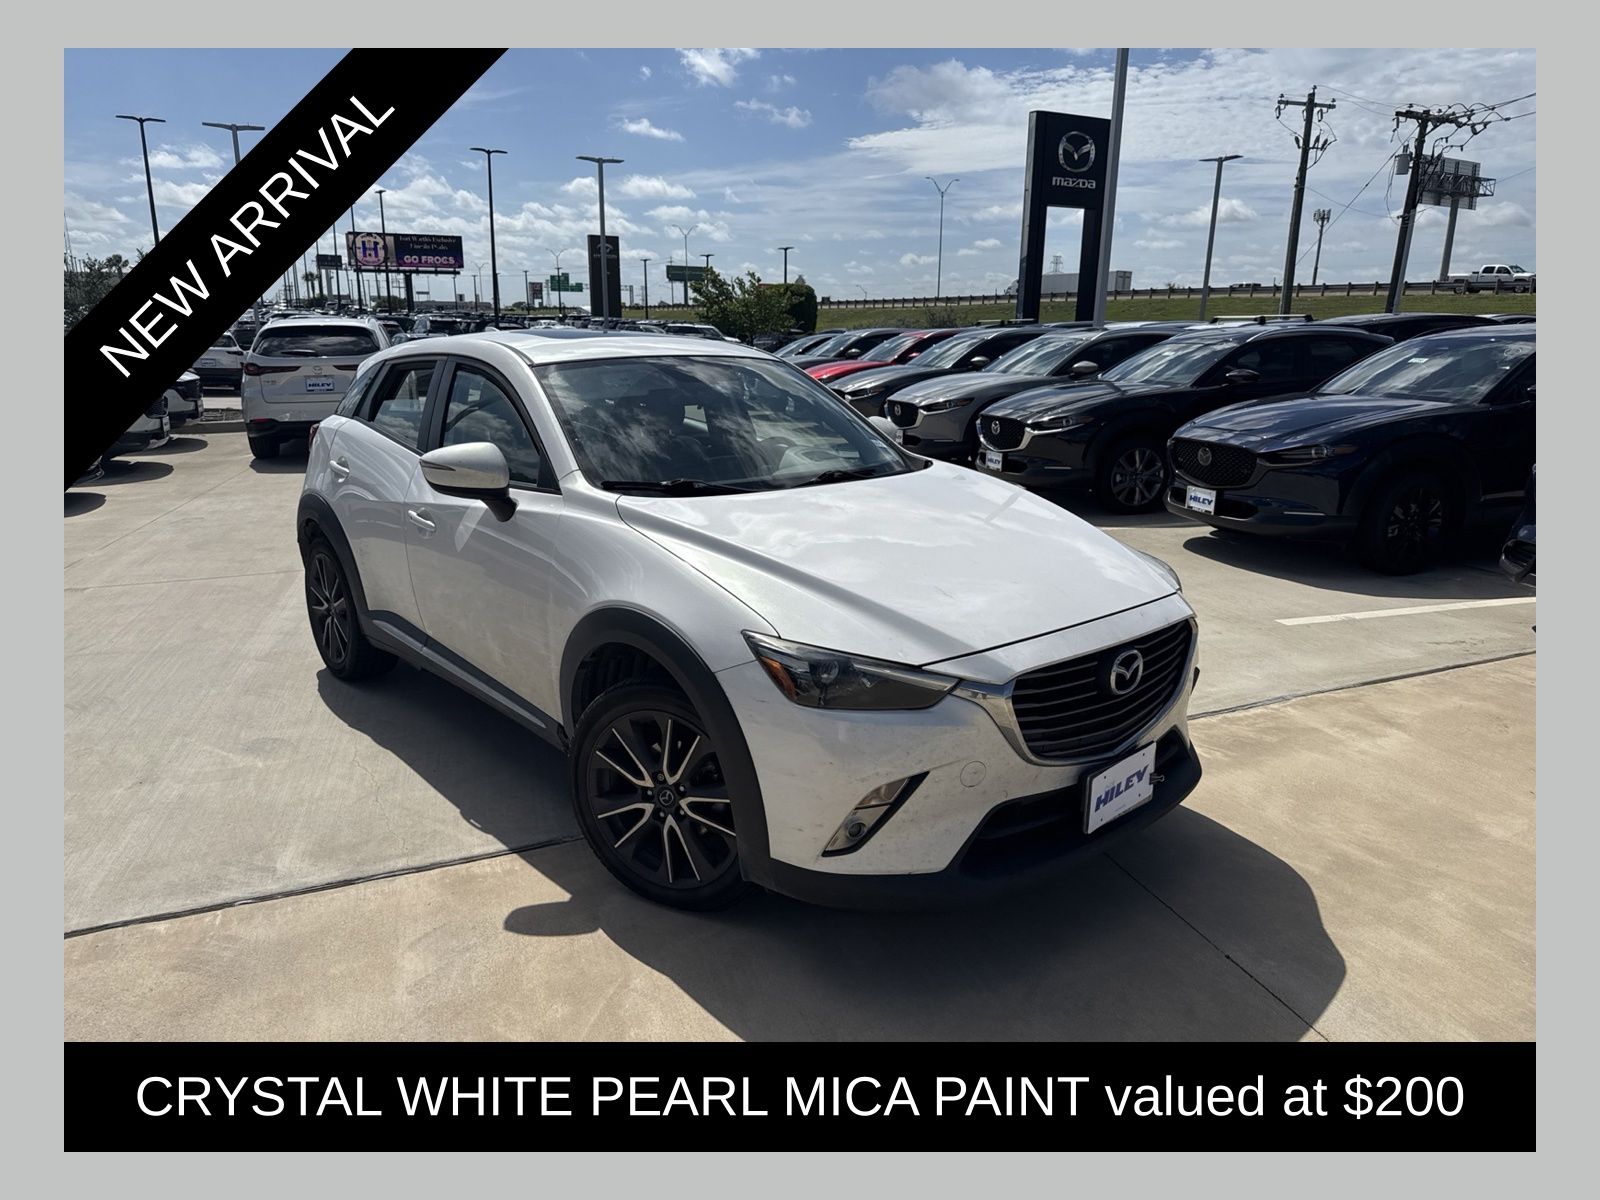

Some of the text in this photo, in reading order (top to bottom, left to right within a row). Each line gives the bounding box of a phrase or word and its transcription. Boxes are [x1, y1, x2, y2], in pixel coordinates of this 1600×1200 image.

[403, 255, 455, 265] GO FROGS
[1189, 494, 1213, 506] HILEY
[1095, 764, 1150, 813] HILEY
